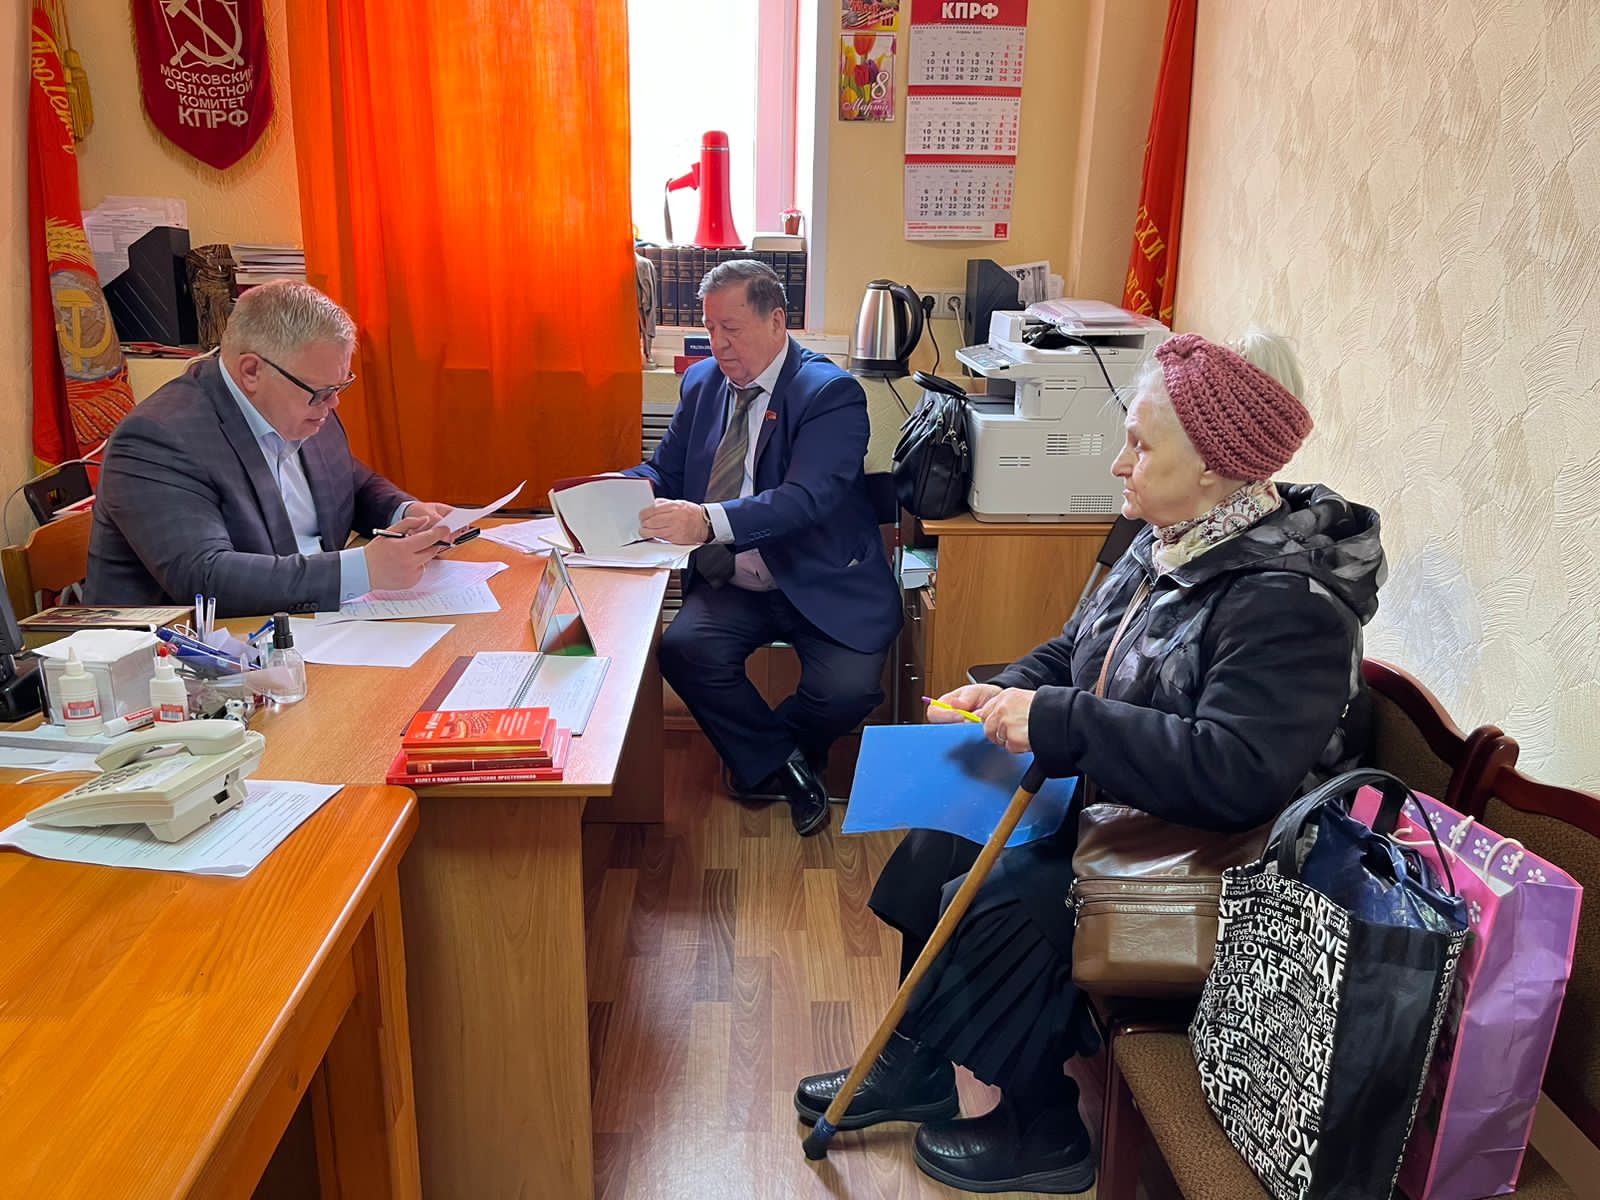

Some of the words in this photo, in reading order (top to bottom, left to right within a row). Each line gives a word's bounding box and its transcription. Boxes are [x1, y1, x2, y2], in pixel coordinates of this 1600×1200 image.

[942, 2, 999, 19] КПРФ
[871, 72, 889, 99] 8
[179, 94, 246, 109] КОМИТЕТ
[179, 107, 249, 128] КПРФ
[1260, 907, 1282, 920] LOVE
[1284, 916, 1299, 926] ART
[1261, 898, 1280, 908] LOVE
[1281, 904, 1294, 913] ART
[1303, 891, 1335, 924] ART
[1309, 916, 1348, 962] LOVE
[1227, 960, 1251, 969] ART
[1234, 942, 1277, 965] LOVE
[1279, 958, 1304, 981] ART
[1249, 958, 1292, 993] ART
[1225, 984, 1263, 1008] ART
[1219, 1012, 1240, 1026] ART
[1227, 1000, 1262, 1022] LOVE
[1264, 1017, 1284, 1036] ART
[1239, 1015, 1273, 1046] ART
[1219, 1030, 1251, 1049] ART
[1299, 1032, 1333, 1065] ART
[1298, 1047, 1331, 1079] LOVE
[1214, 1063, 1251, 1093] ART
